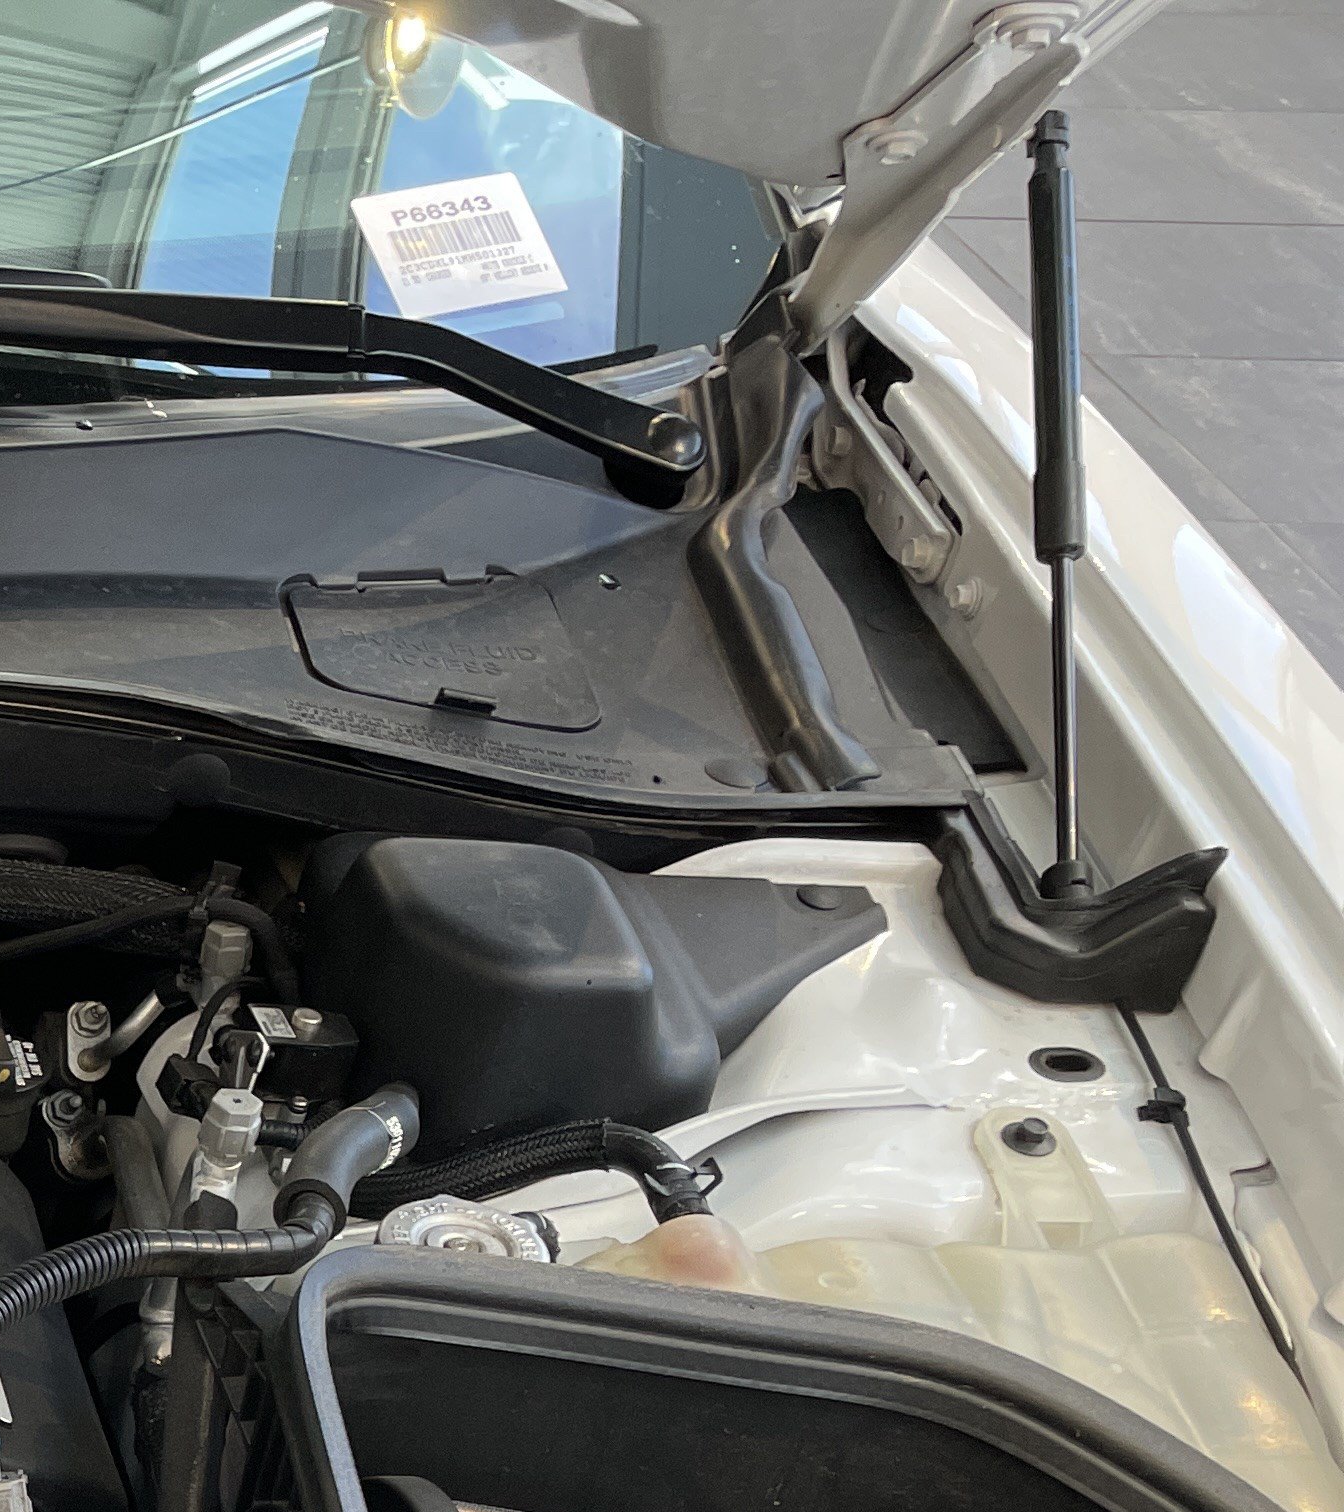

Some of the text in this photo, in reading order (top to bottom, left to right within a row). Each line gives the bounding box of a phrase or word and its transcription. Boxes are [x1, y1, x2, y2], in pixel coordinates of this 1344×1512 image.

[391, 195, 493, 227] P66343
[449, 641, 538, 662] FLUID
[388, 652, 504, 677] ACCESS
